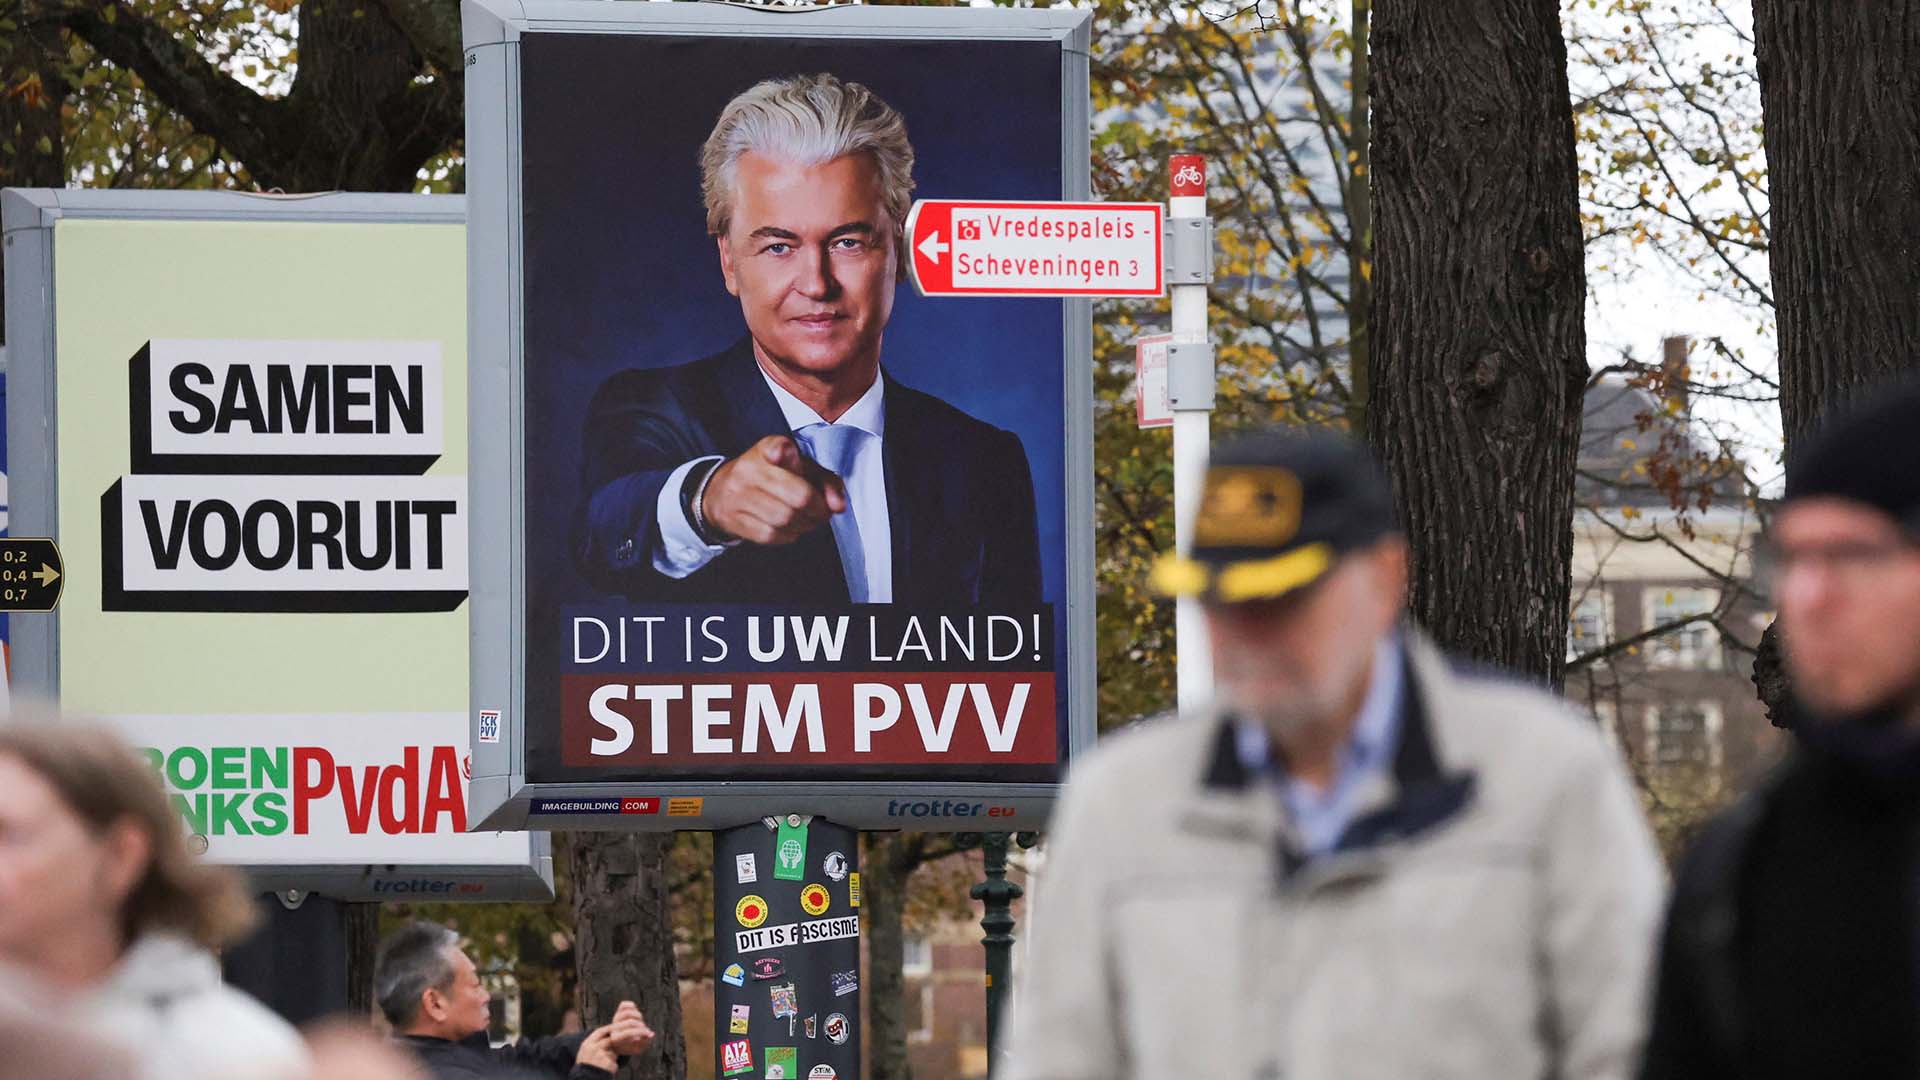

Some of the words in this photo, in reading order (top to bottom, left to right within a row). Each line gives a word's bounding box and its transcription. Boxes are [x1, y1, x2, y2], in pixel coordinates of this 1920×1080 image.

[987, 214, 1135, 243] Vredespaleis
[958, 253, 1120, 283] Scheveningen
[1129, 260, 1139, 277] 3
[168, 362, 424, 434] SAMEN
[139, 499, 457, 571] VOORUIT
[3, 551, 28, 564] 0,2
[2, 570, 27, 583] 0,4
[4, 589, 28, 602] 0,7
[573, 616, 666, 664] DIT
[685, 616, 728, 663] IS
[747, 615, 850, 663] UW
[870, 613, 1041, 663] LAND!
[480, 715, 498, 727] FCK
[480, 726, 497, 737] PVV
[588, 683, 826, 757] STEM
[853, 682, 1031, 753] PVV
[292, 746, 468, 835] PvdA
[168, 792, 289, 837] NKS
[739, 931, 764, 950] DIT
[769, 928, 785, 945] IS
[790, 917, 859, 942] FASCISME
[724, 1040, 750, 1063] A12
